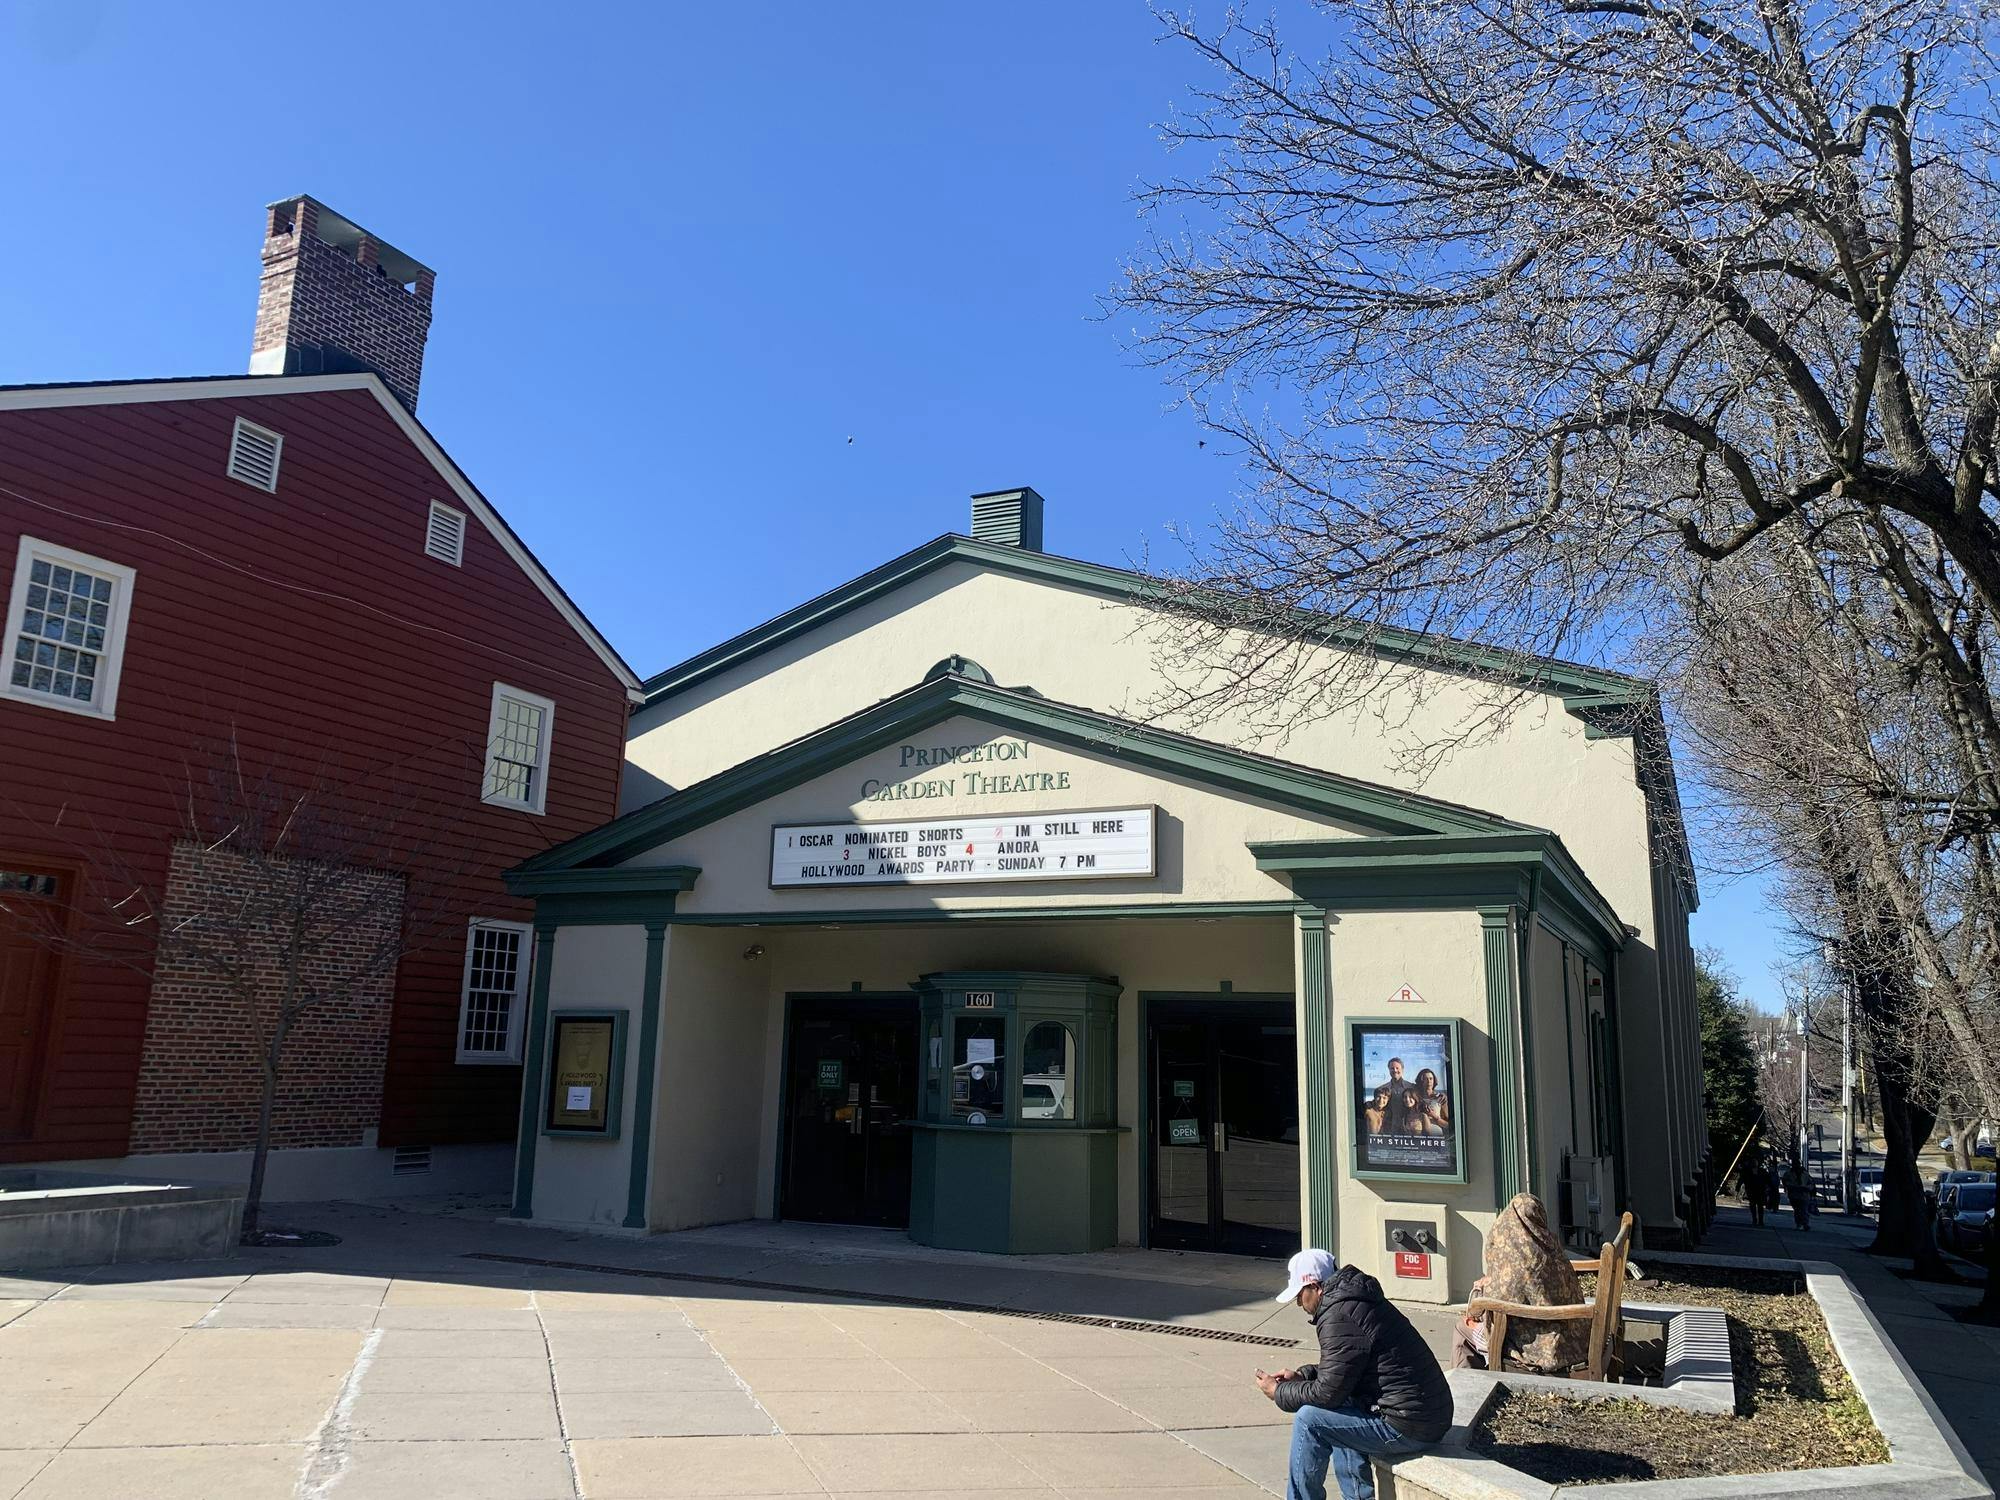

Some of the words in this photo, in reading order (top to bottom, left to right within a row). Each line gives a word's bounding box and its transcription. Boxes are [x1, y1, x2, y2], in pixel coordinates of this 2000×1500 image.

[899, 741, 1030, 767] PRINCETON
[861, 779, 955, 802] GARDEN
[963, 771, 1071, 796] THEATRE
[800, 834, 833, 847] OSCAR
[845, 832, 909, 845] NOMINATED
[918, 828, 963, 842] SHORTS
[1015, 825, 1031, 837] IM
[1044, 822, 1080, 836] STILL
[1092, 820, 1123, 834] HERE
[843, 849, 850, 860] 3
[868, 847, 907, 860] NICKEL
[917, 845, 947, 857] BOYS
[965, 843, 974, 855] 4
[997, 840, 1040, 854] ANORA
[801, 864, 865, 878] HOLLYWOOD
[878, 861, 925, 875] AWARDS
[936, 860, 975, 873] PARTY
[997, 856, 1046, 870] SUNDAY
[1059, 856, 1067, 868] 7
[1077, 855, 1096, 868] PM
[969, 993, 990, 1006] 160
[1402, 989, 1411, 1000] R
[1172, 1128, 1197, 1137] OPEN
[1388, 1138, 1415, 1146] STILL
[1420, 1139, 1446, 1147] HERE
[1403, 1254, 1420, 1264] FDC
